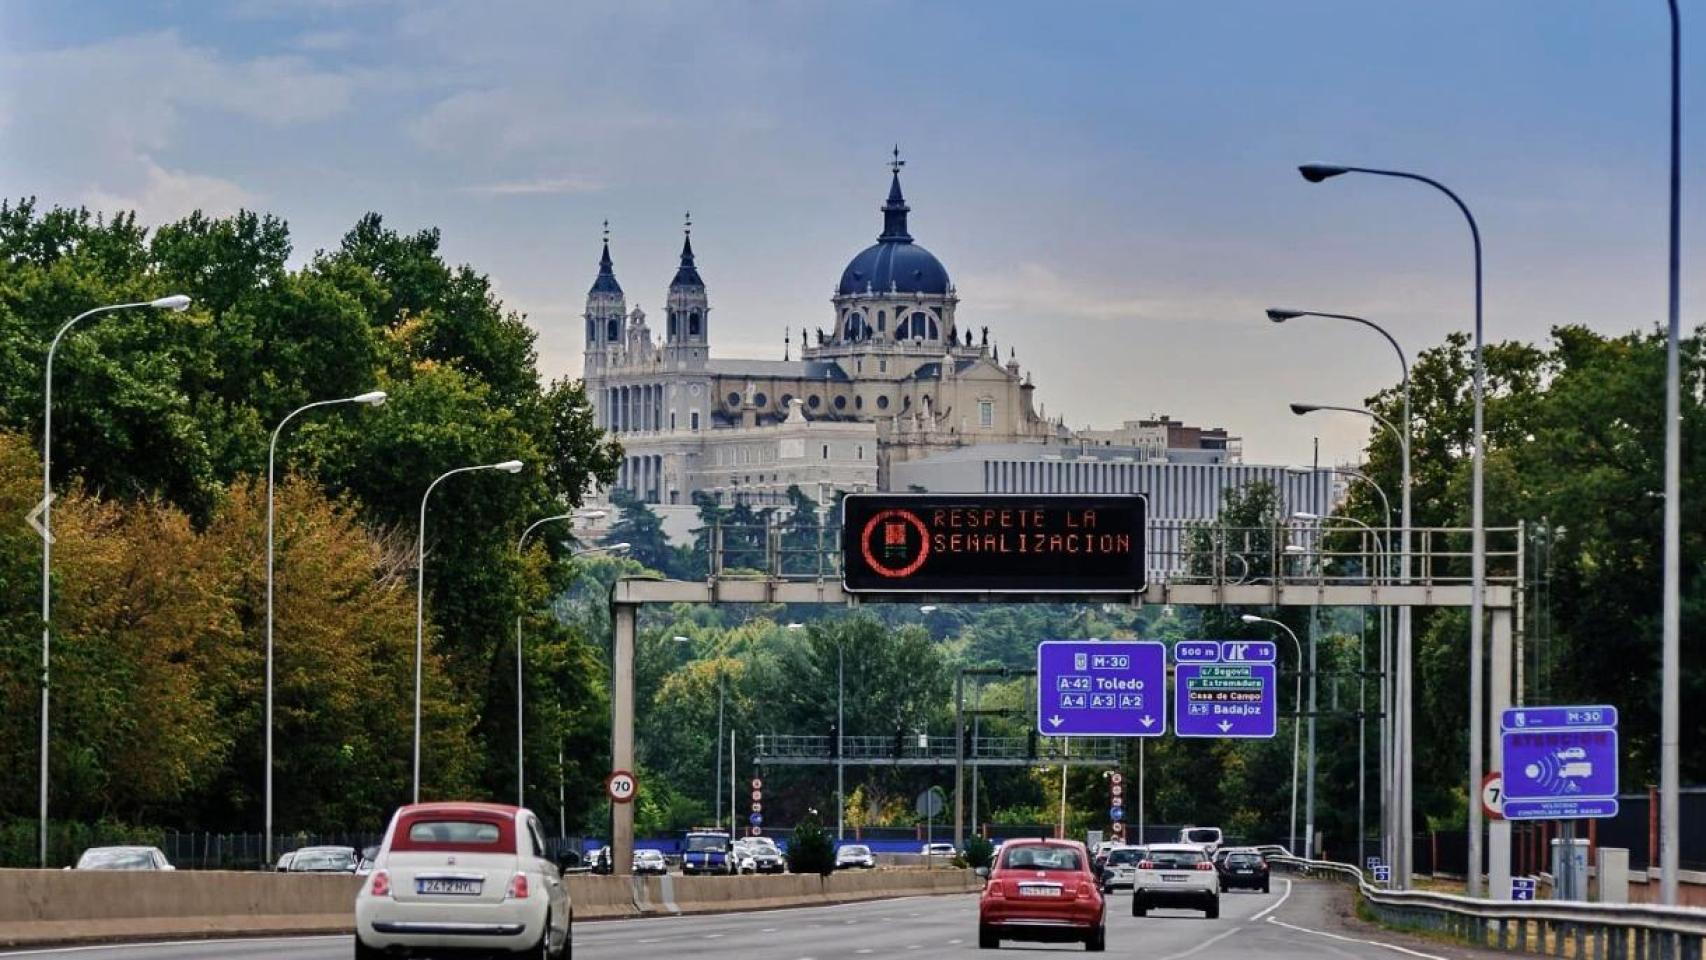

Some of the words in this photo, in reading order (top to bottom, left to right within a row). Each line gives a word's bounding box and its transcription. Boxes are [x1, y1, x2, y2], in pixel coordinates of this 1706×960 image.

[934, 510, 1044, 527] RESPETE
[1066, 510, 1097, 527] LA
[1181, 647, 1202, 656] 500
[1205, 648, 1214, 656] m
[1094, 657, 1127, 667] M-30
[1214, 667, 1249, 678] Segovia
[1060, 678, 1089, 688] A-42
[1096, 677, 1144, 690] Toledo
[1203, 679, 1262, 687] Extremadura
[1063, 695, 1084, 706] A-4
[1092, 695, 1114, 706] A-3
[1122, 695, 1142, 706] A-2
[1190, 692, 1213, 700] Casa
[1216, 692, 1228, 700] de
[1230, 692, 1260, 701] Campo
[1214, 703, 1261, 716] Badajoz
[614, 781, 630, 791] 70
[1489, 788, 1501, 803] 7
